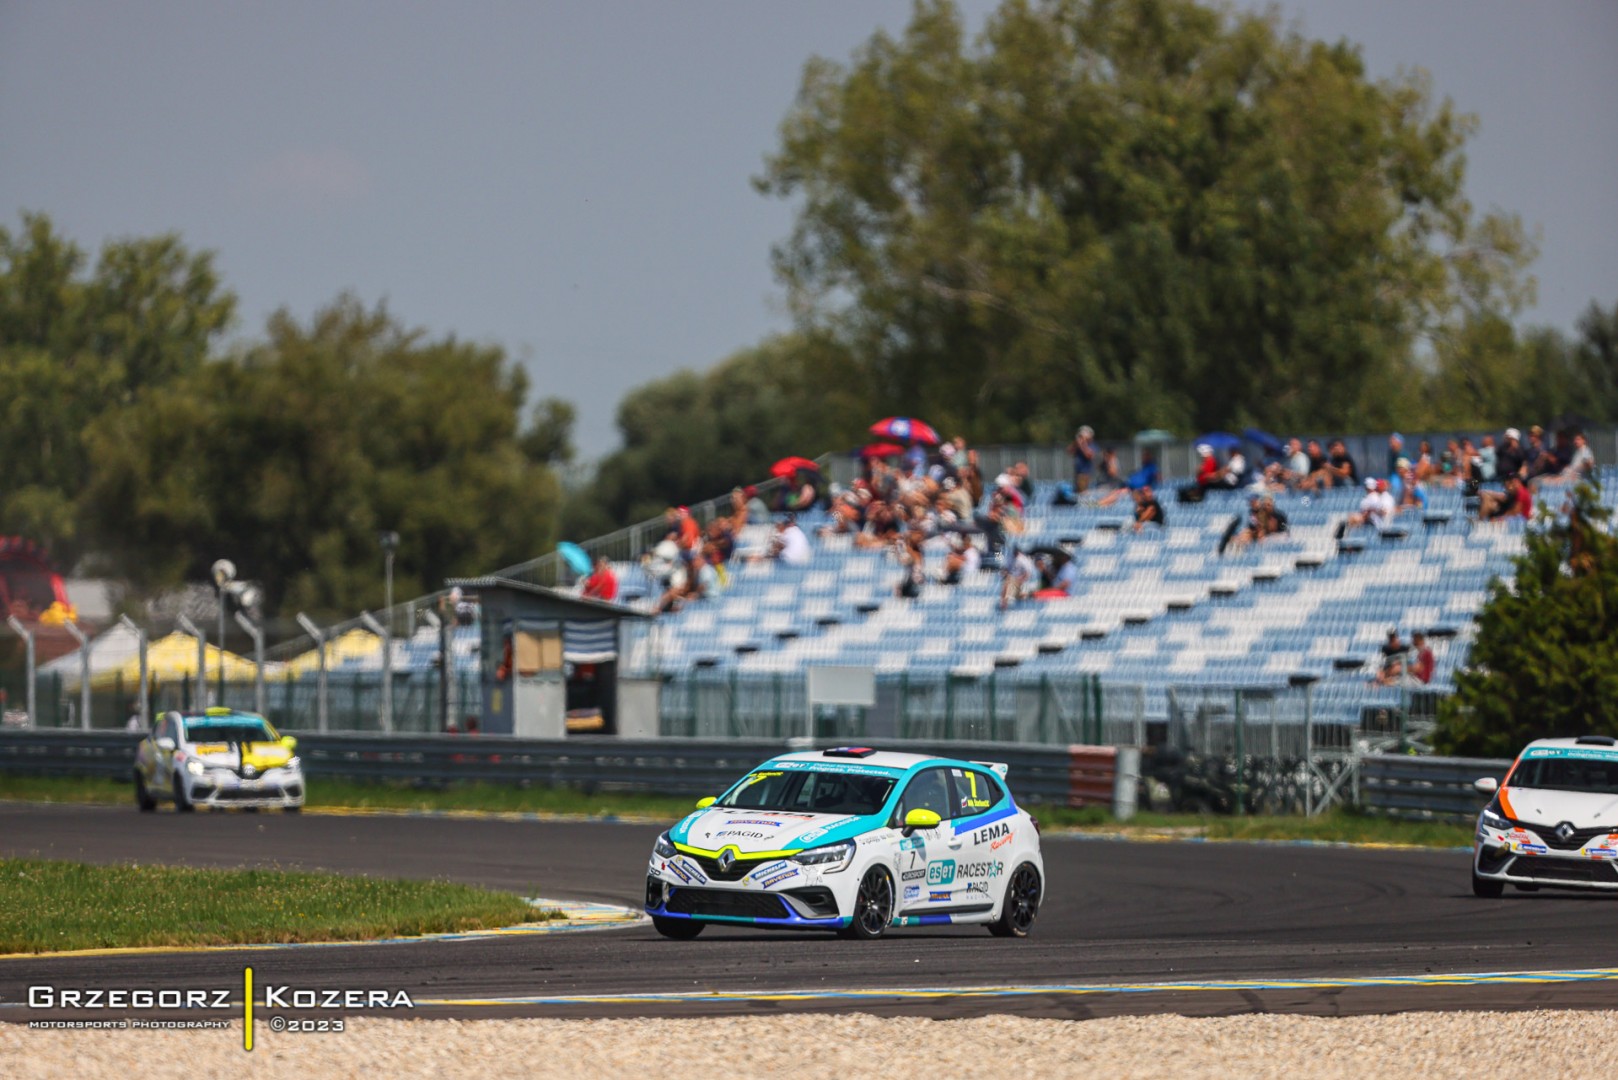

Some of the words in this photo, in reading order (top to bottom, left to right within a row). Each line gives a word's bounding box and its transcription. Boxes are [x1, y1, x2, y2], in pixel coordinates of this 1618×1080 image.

[847, 768, 891, 776] Protected.
[727, 830, 763, 839] PAGID
[973, 822, 1010, 846] LEMA
[910, 850, 916, 869] 7
[972, 881, 989, 894] PAGID
